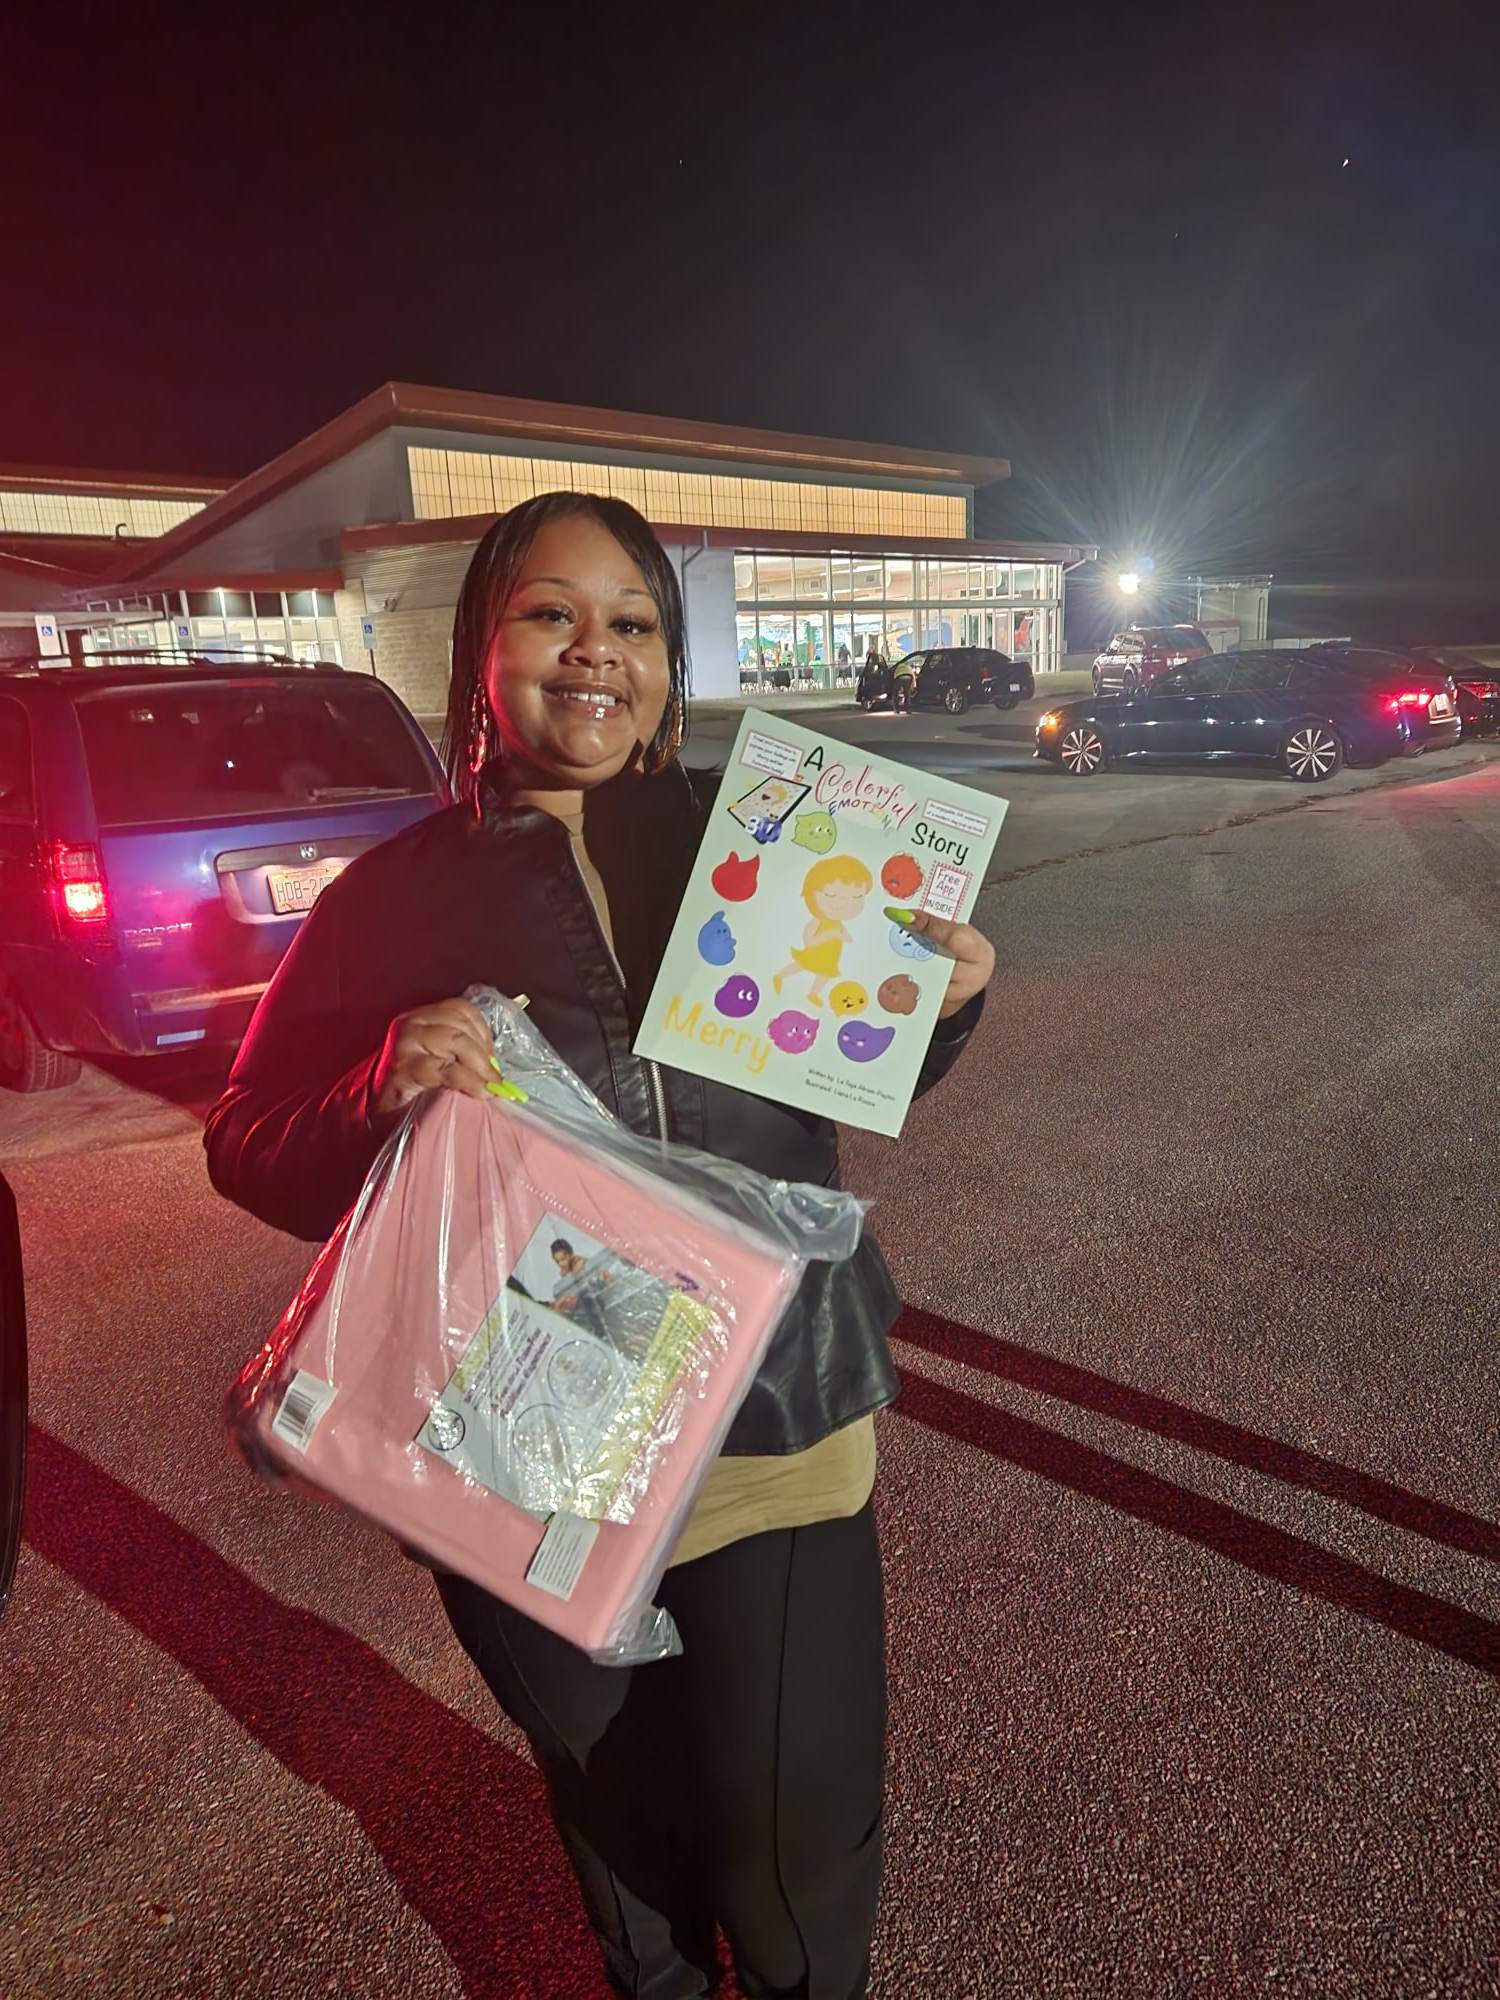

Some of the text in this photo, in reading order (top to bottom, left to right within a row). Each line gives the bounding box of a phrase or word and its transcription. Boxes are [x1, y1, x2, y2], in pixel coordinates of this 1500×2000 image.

[803, 745, 823, 771] A
[815, 763, 919, 831] Colorful
[911, 822, 969, 866] Story
[936, 880, 956, 897] App
[938, 868, 960, 886] Free
[925, 899, 955, 915] INSIDE
[662, 992, 773, 1074] Merry
